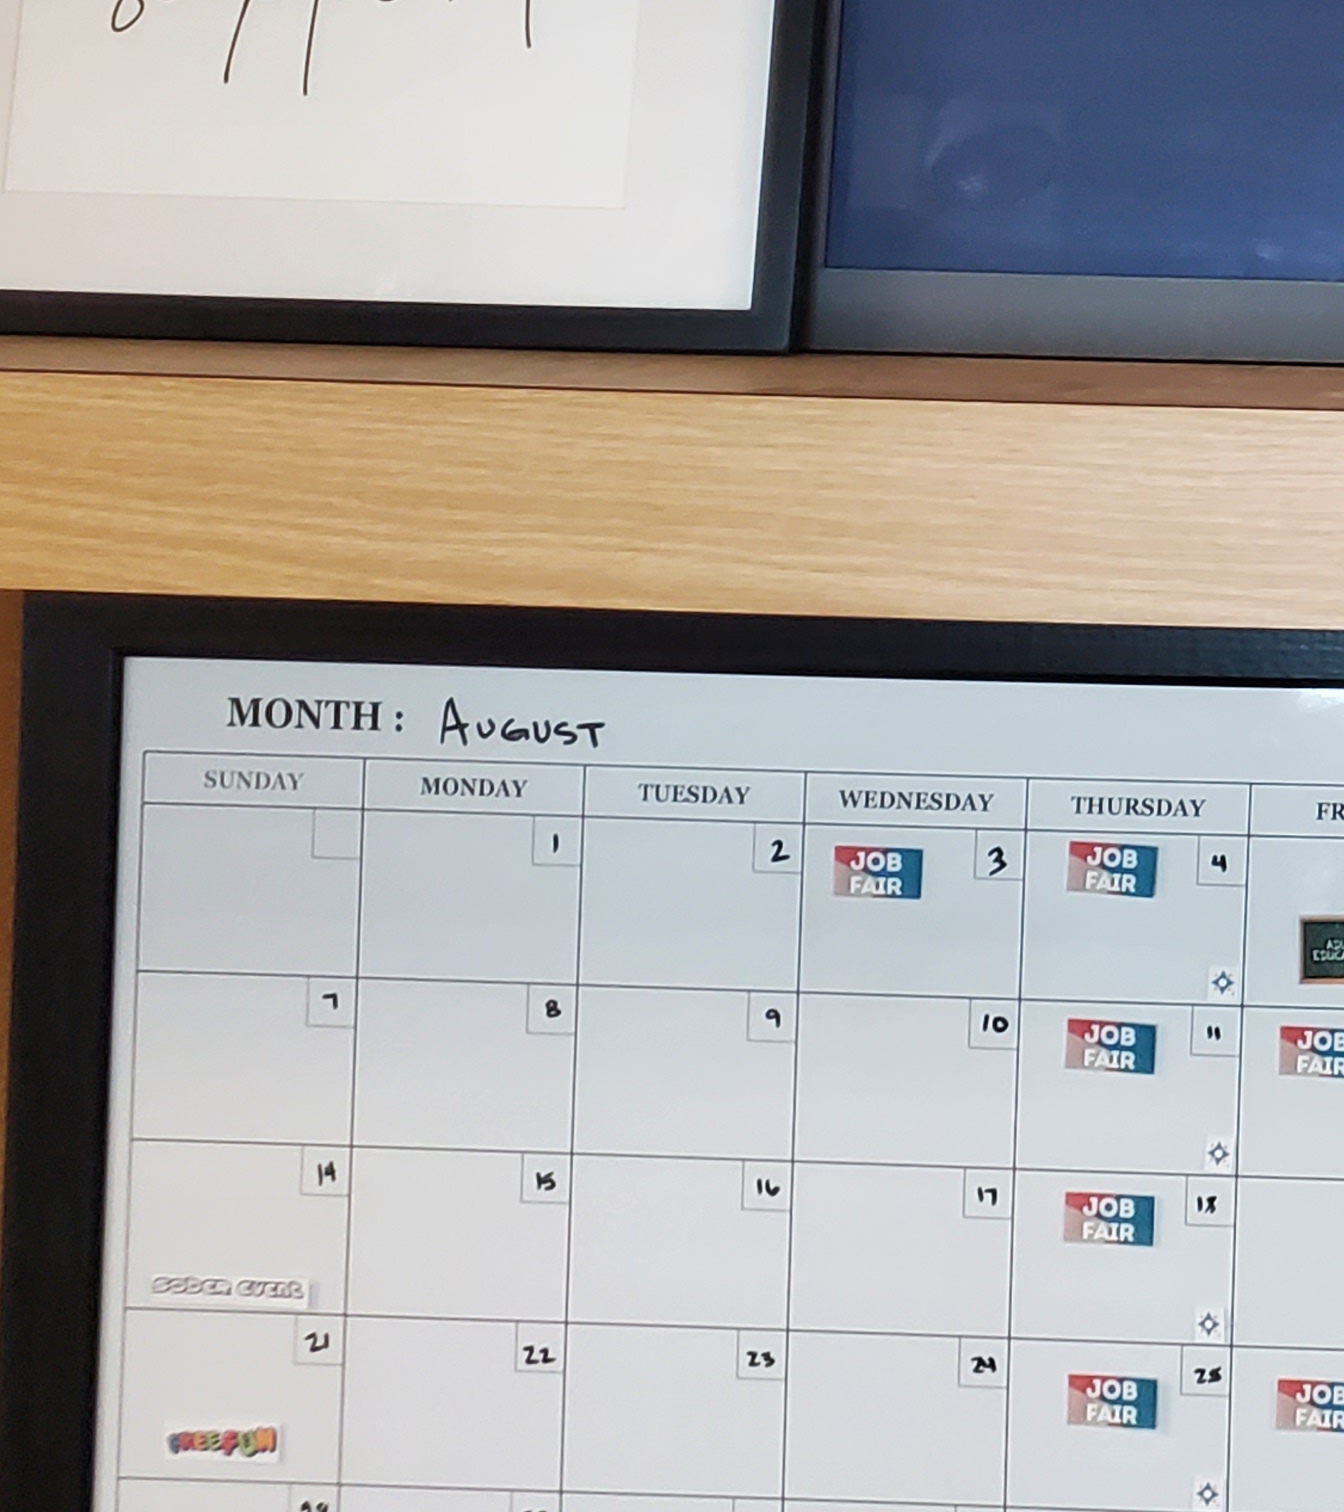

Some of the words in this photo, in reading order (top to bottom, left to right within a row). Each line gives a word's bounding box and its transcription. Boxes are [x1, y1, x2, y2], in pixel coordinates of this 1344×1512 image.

[227, 697, 382, 731] MONTH
[204, 770, 305, 791] SUNDAY
[421, 776, 528, 798] MONDAY
[638, 783, 750, 805] TUESDAY
[839, 789, 994, 812] WEDNESDAY
[1071, 796, 1206, 817] THURSDAY
[552, 833, 559, 853] 1
[770, 839, 791, 863] 2
[849, 849, 903, 873] JOB
[987, 846, 1008, 876] 3
[1085, 845, 1139, 870] JOB
[1211, 854, 1227, 873] 4
[849, 874, 903, 897] FAIR
[1084, 869, 1137, 894] FAIR
[322, 992, 339, 1010] 7
[545, 999, 562, 1019] 8
[765, 1008, 781, 1028] 9
[982, 1013, 1009, 1034] 10
[1084, 1022, 1136, 1047] JOB
[1206, 1025, 1221, 1041] 11
[1084, 1047, 1136, 1072] FAIR
[317, 1161, 336, 1186] 14
[535, 1171, 557, 1191] 15
[756, 1178, 781, 1197] 16
[977, 1186, 998, 1206] 17
[1081, 1195, 1136, 1220] JOB
[1081, 1219, 1135, 1243] FAIR
[304, 1332, 330, 1353] 21
[522, 1345, 556, 1365] 22
[746, 1350, 776, 1368] 23
[971, 1356, 997, 1374] 24
[1084, 1378, 1138, 1402] JOB
[1084, 1403, 1138, 1427] FAIR
